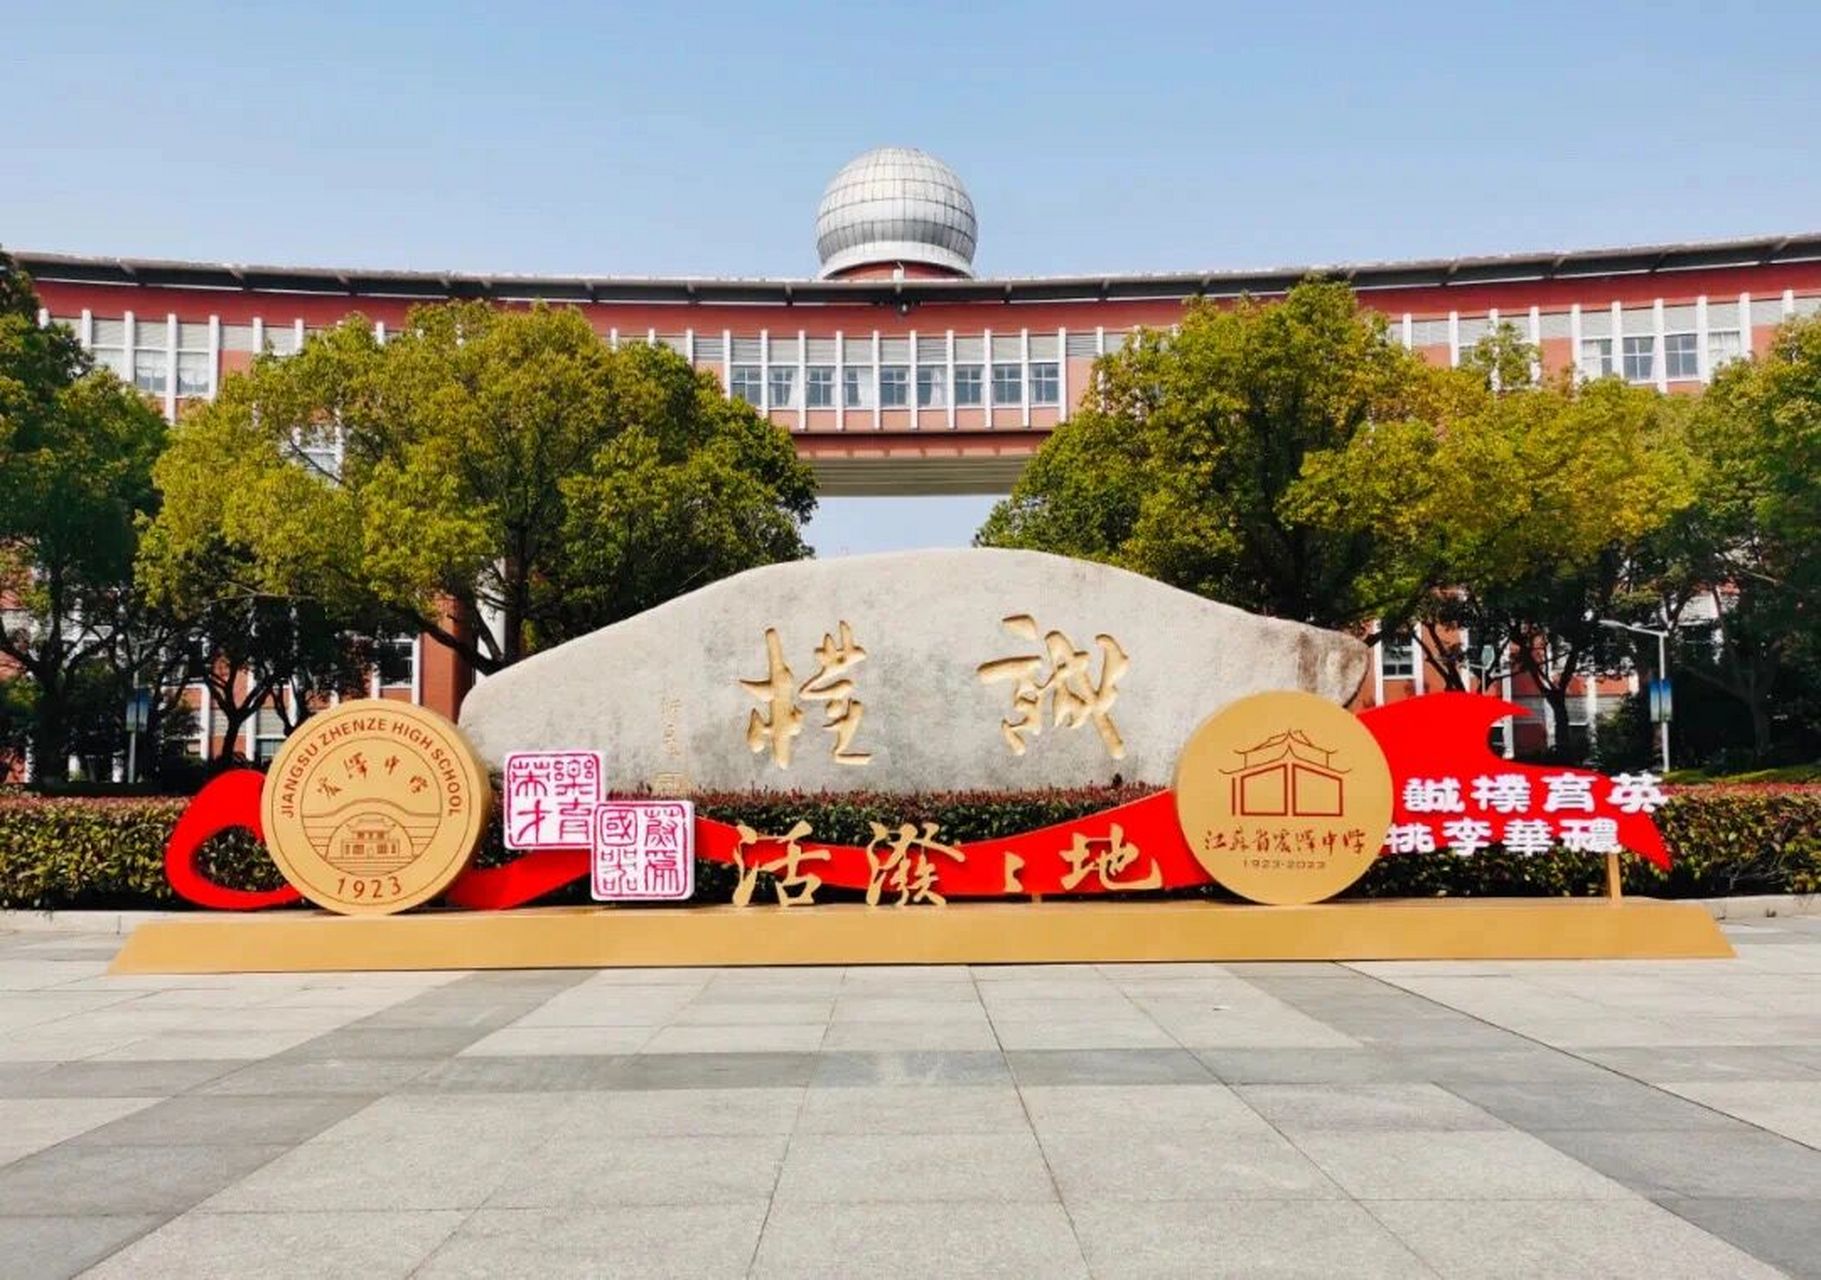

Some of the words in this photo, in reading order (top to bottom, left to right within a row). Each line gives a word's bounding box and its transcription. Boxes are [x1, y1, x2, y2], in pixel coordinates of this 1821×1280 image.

[280, 742, 319, 819] JIANGSU
[320, 717, 388, 746] ZHENZE
[391, 718, 433, 750] HIGH
[430, 747, 463, 817] SCHOOL
[336, 876, 403, 900] 1923
